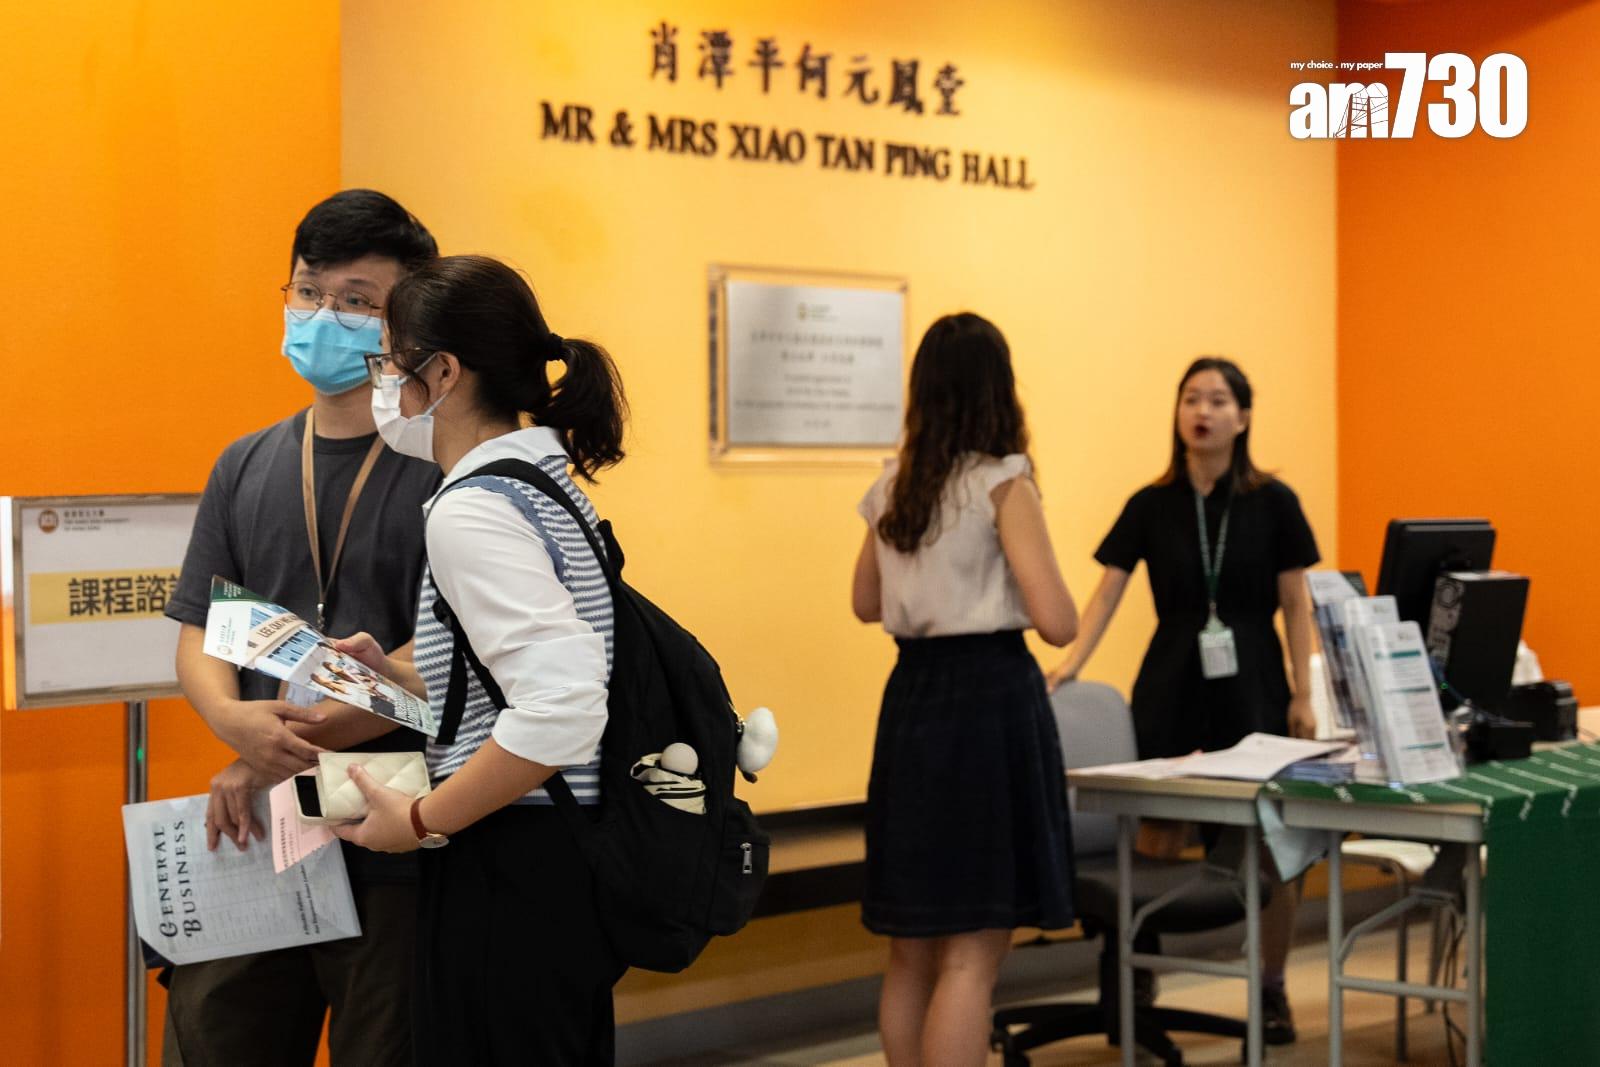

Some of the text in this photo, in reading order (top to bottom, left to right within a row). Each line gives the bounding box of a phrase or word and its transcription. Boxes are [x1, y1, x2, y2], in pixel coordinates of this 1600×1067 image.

[540, 101, 1036, 190] MR & MRS XIAO TAN PING HALL
[153, 826, 179, 938] GENERAL
[173, 820, 202, 938] BUSINESS
